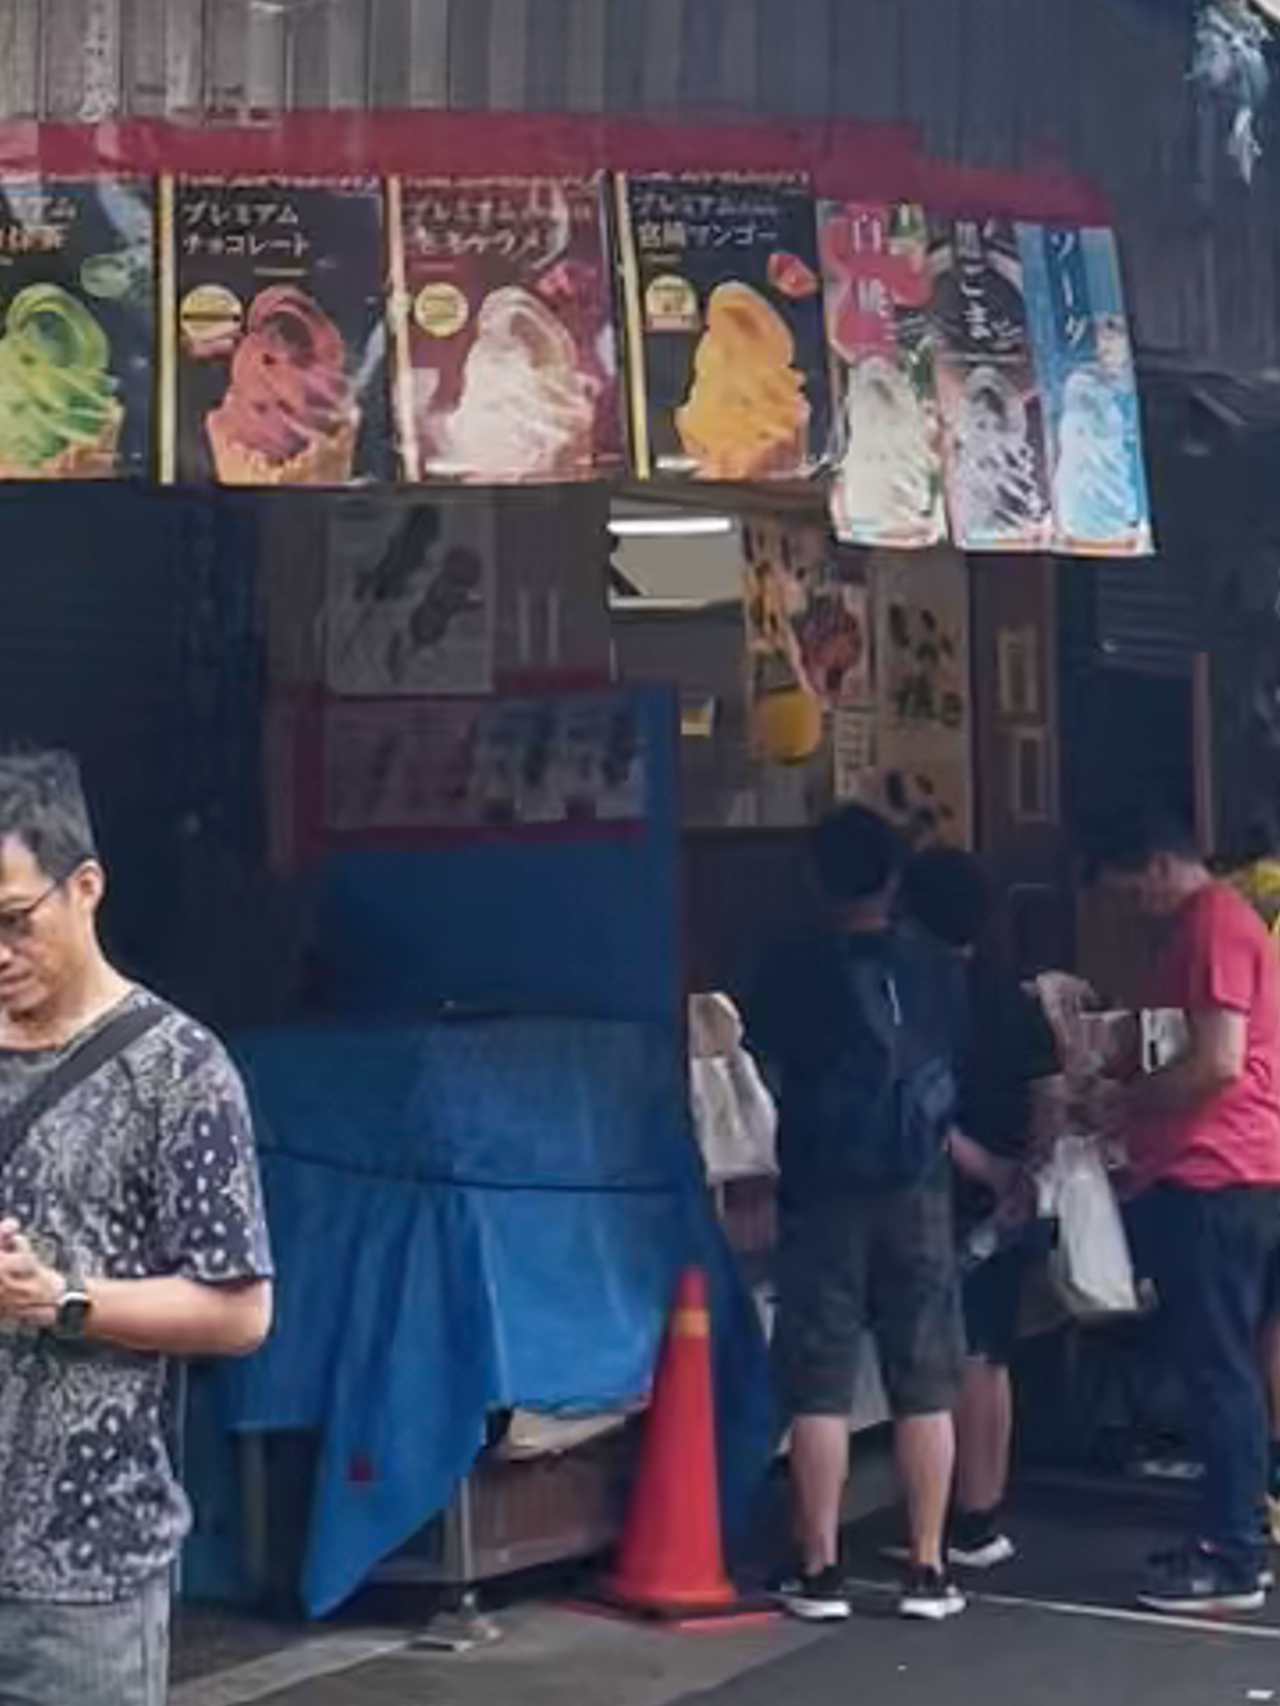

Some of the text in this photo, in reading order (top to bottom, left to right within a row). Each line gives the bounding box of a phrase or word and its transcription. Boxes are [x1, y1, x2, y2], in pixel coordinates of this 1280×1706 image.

[181, 199, 299, 225] プレミアム
[182, 232, 310, 257] チョコレート
